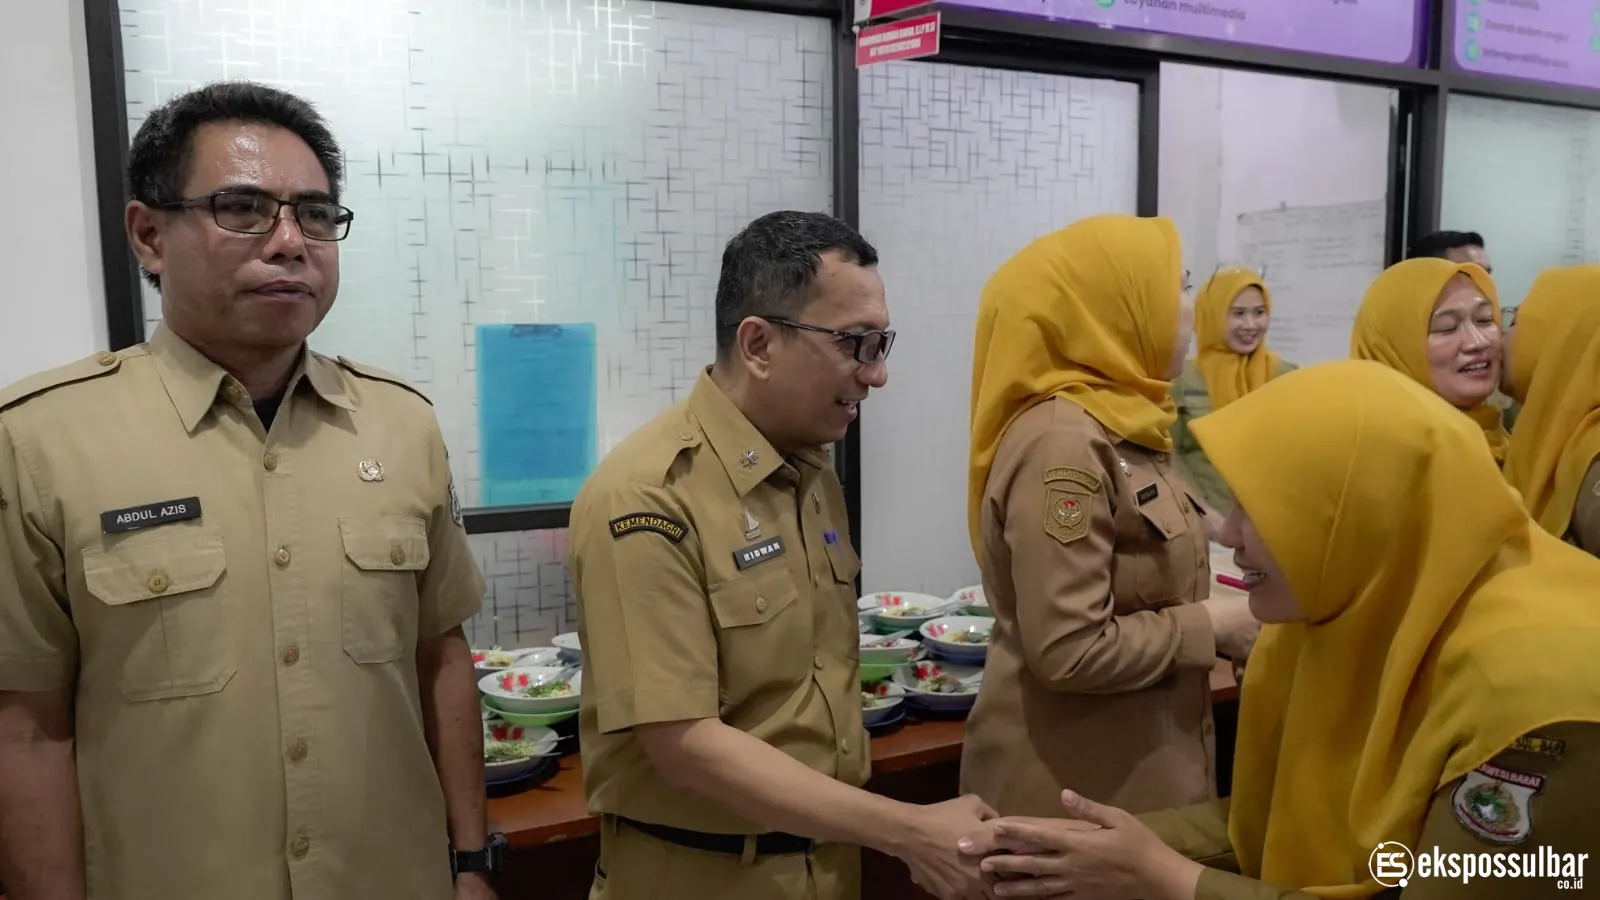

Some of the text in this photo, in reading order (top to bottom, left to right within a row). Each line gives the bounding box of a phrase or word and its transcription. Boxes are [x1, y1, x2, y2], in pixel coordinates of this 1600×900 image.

[1179, 2, 1246, 20] multimedia
[116, 504, 187, 525] ABDUL AZIS
[614, 516, 683, 538] KEMENDAGRI
[743, 542, 781, 562] RIDWAN
